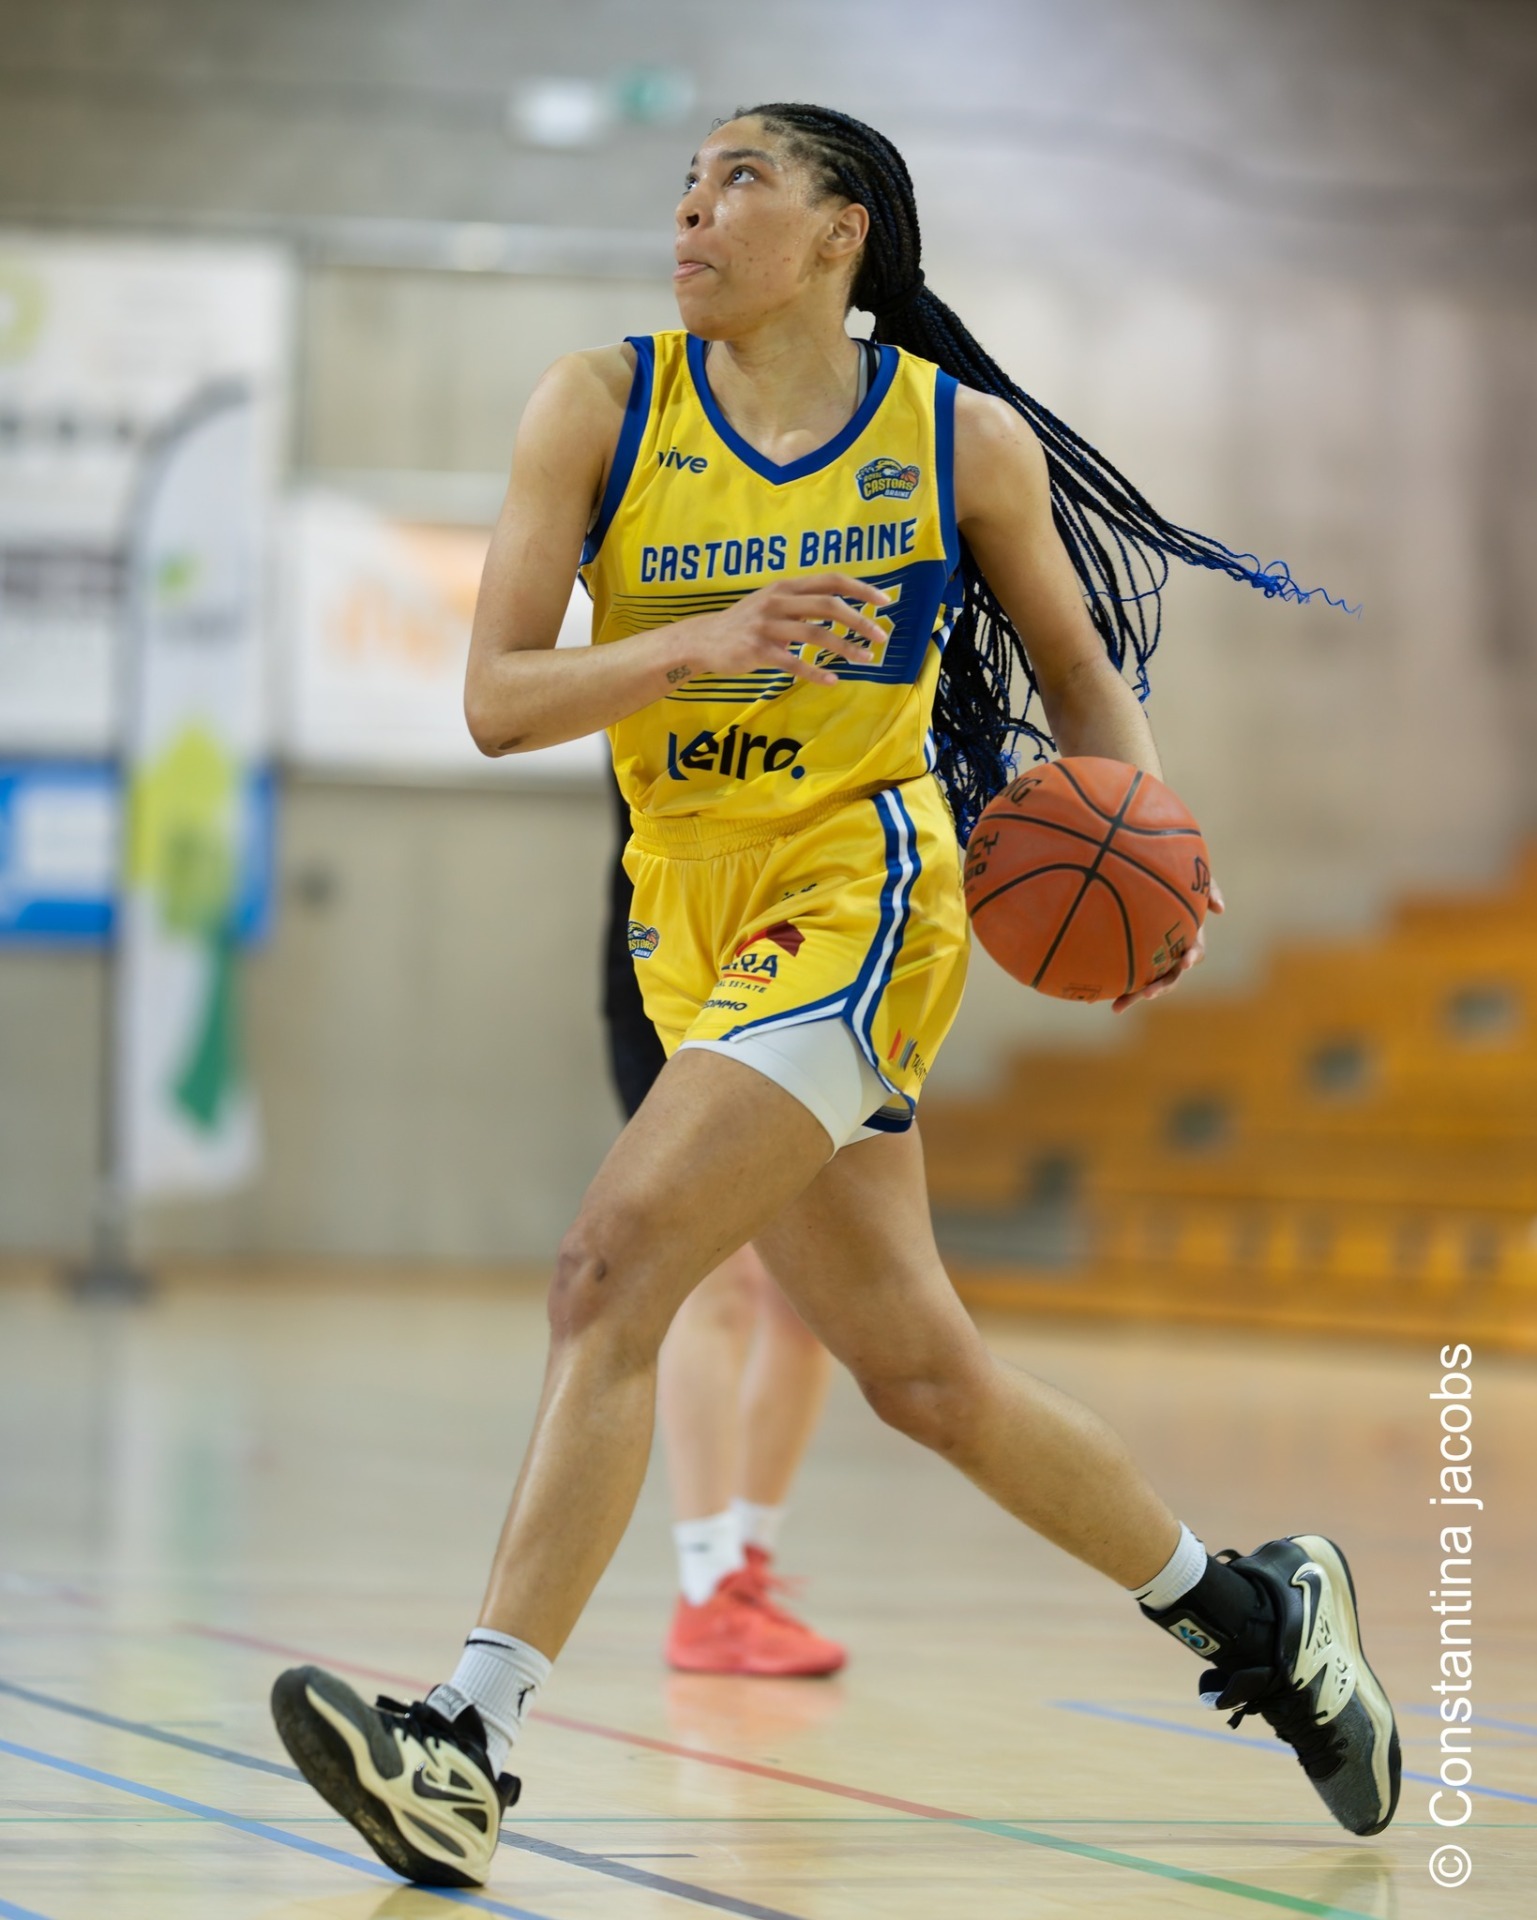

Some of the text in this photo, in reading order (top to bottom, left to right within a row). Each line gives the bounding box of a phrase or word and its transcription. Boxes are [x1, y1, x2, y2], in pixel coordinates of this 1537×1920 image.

[863, 478, 914, 498] CASTORS
[641, 517, 918, 583] CASTORS BRAINE
[728, 981, 767, 993] ESTATE
